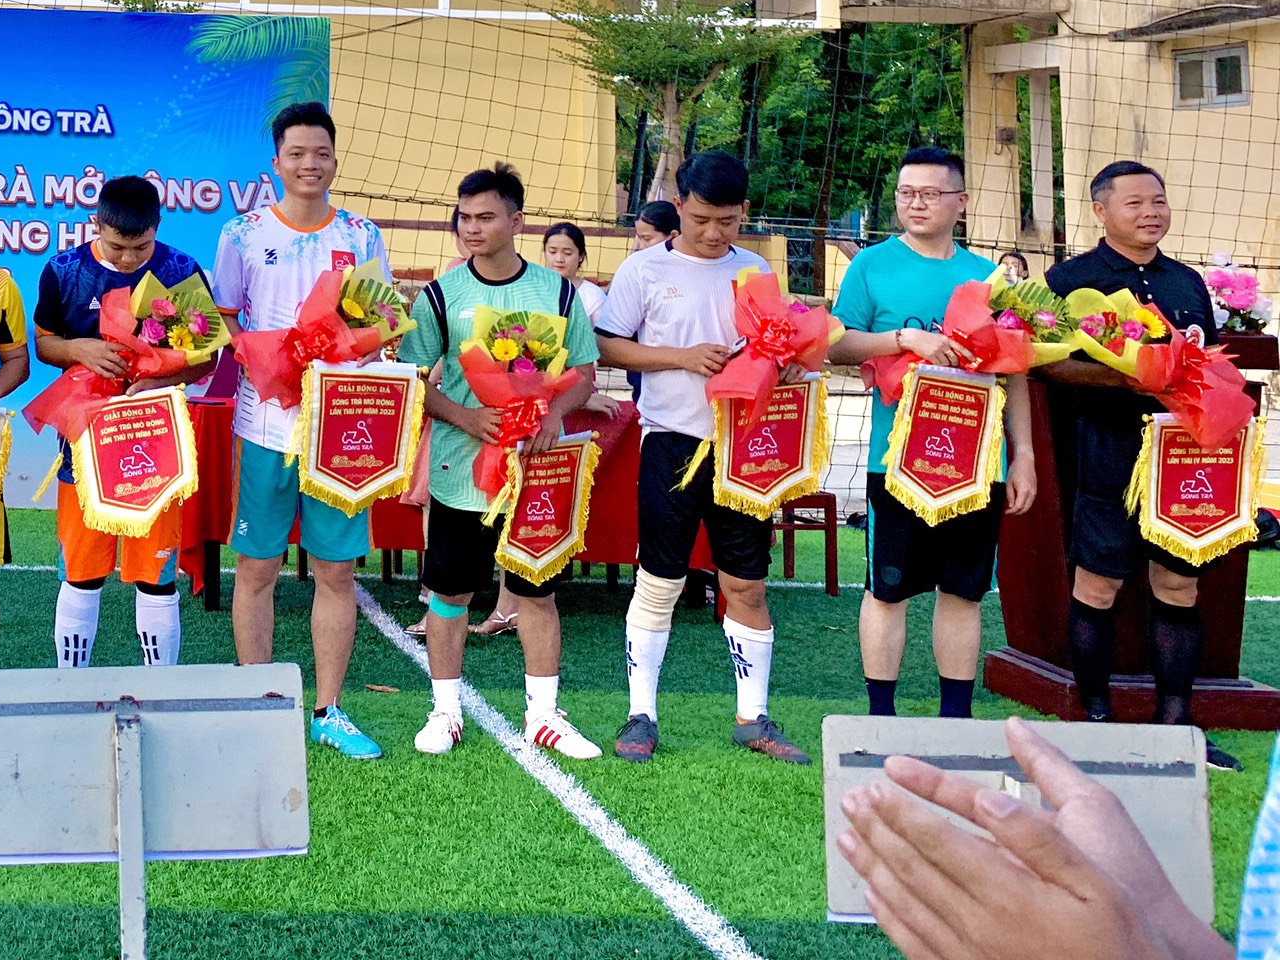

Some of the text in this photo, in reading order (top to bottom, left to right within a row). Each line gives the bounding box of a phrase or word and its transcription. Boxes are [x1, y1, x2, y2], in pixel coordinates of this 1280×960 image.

[57, 106, 112, 133] TRÀ
[44, 165, 105, 207] MỞ
[143, 170, 221, 210] NG
[228, 173, 280, 211] VÀ
